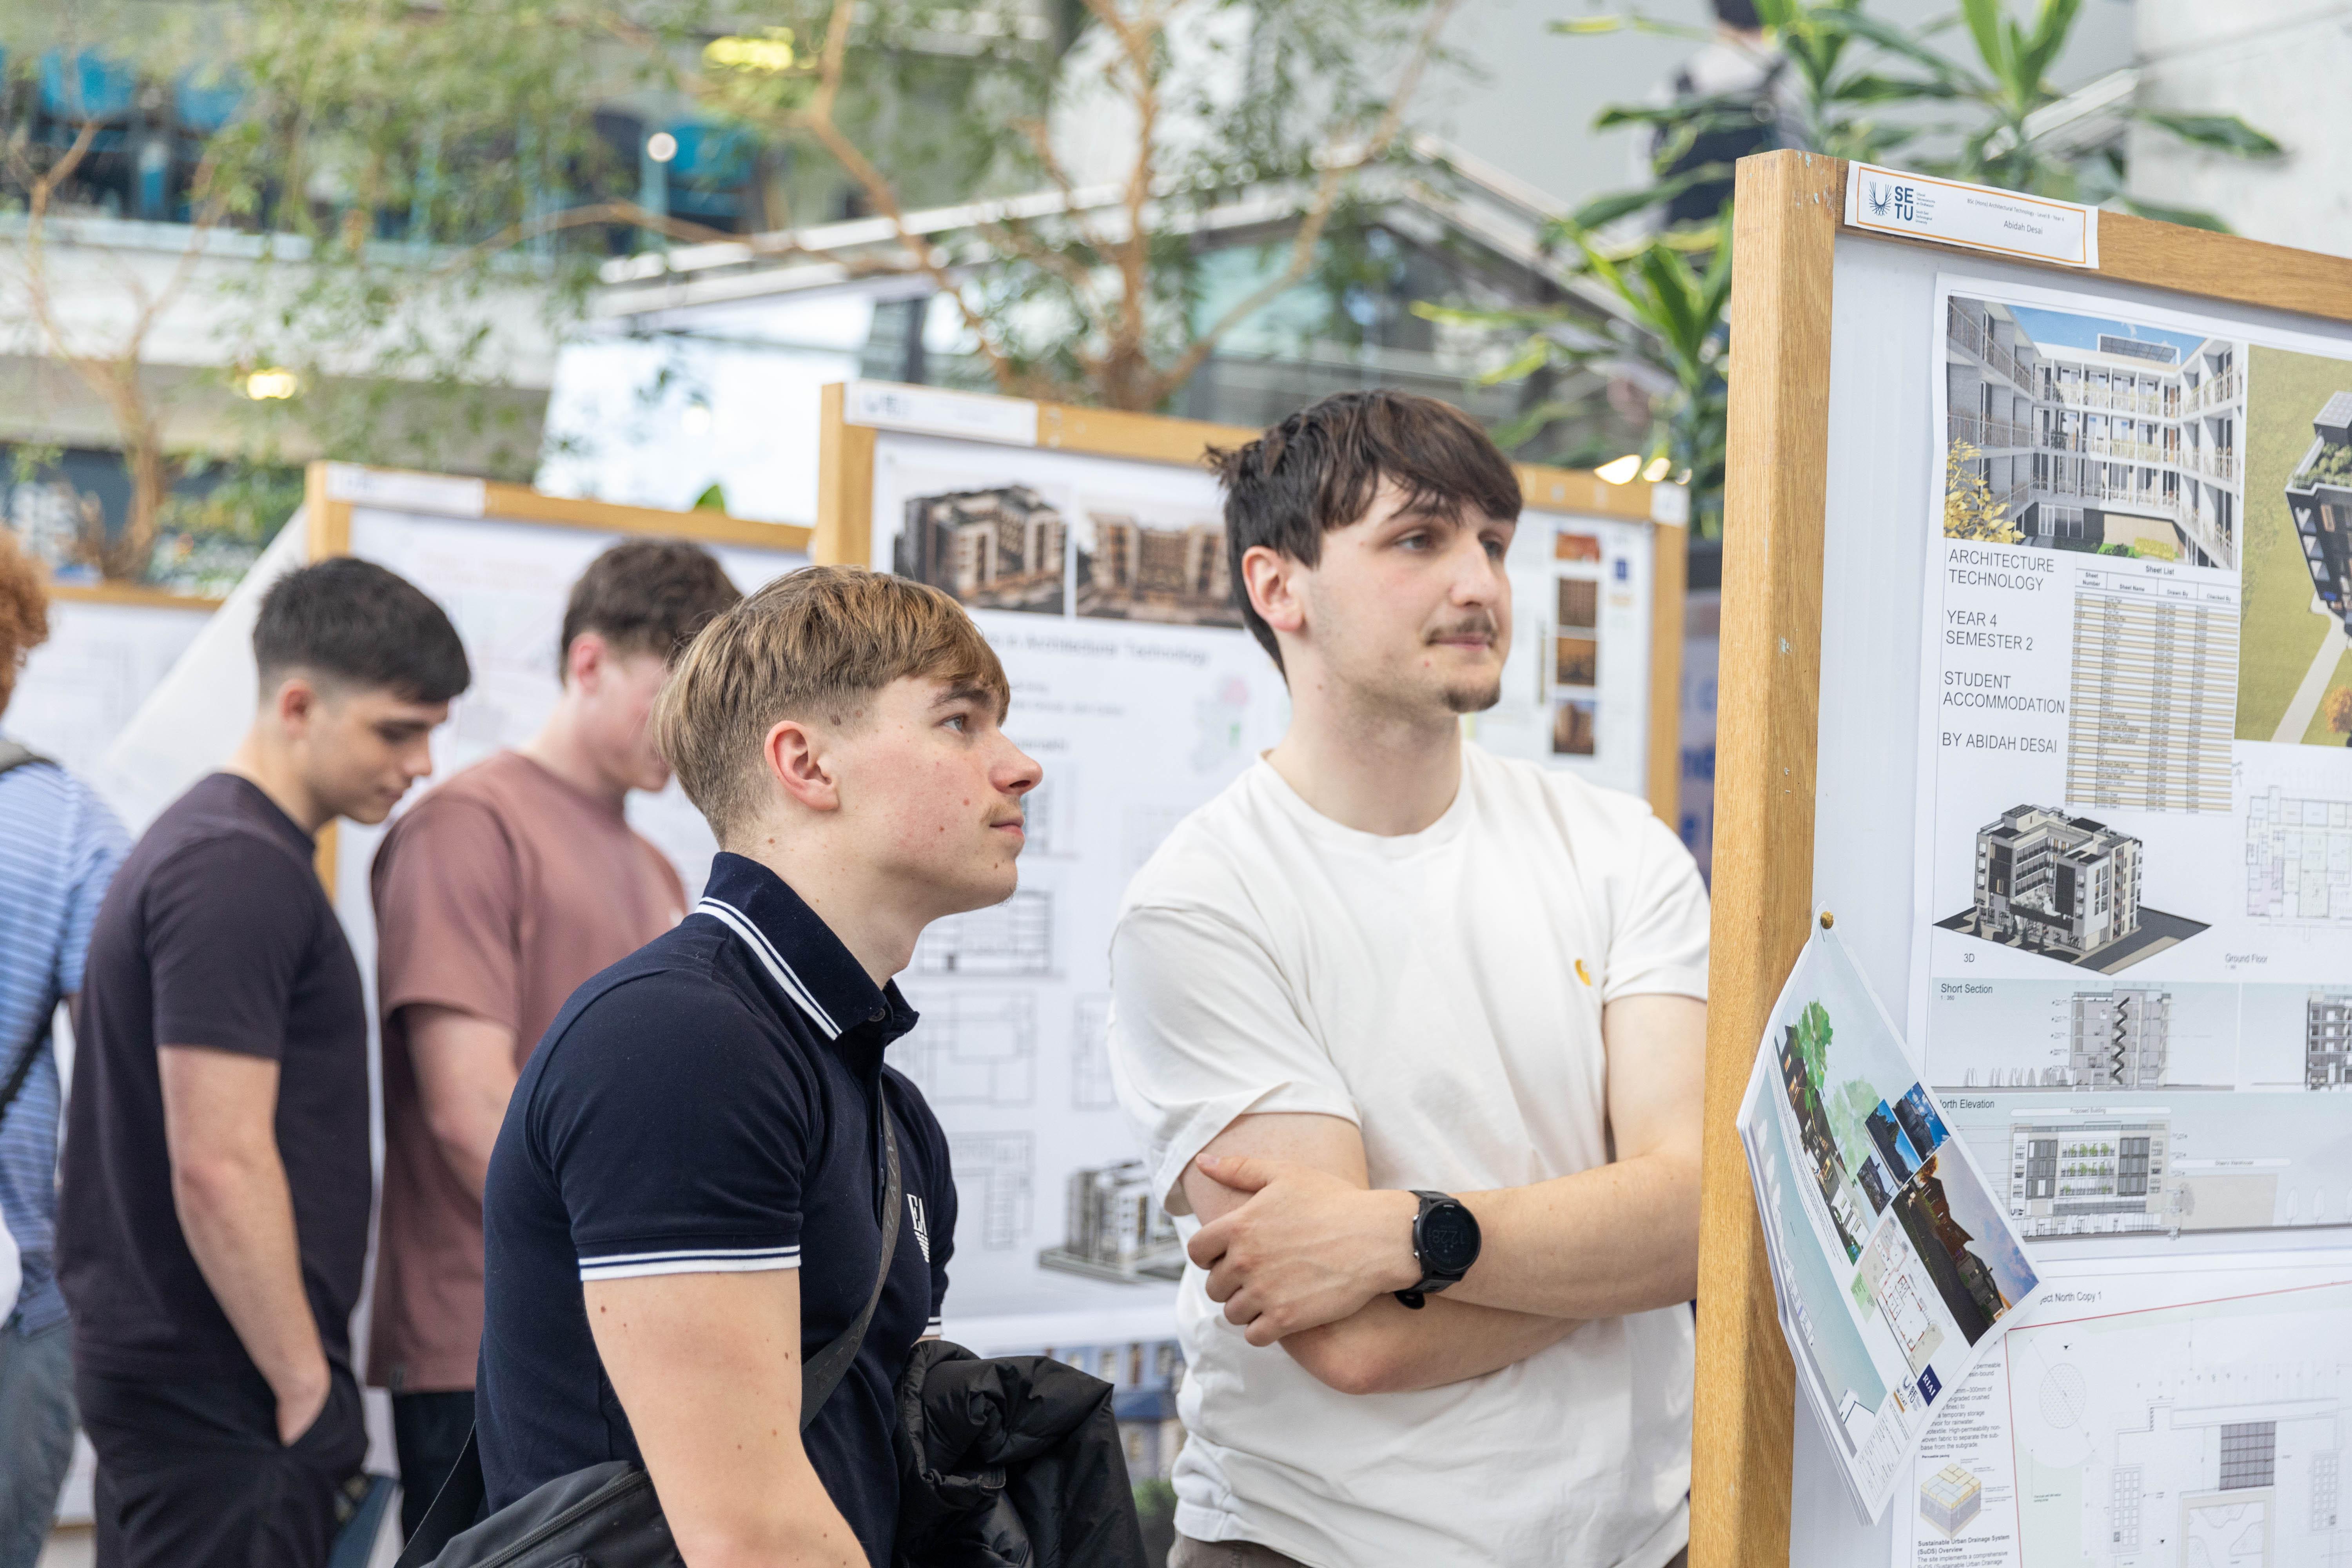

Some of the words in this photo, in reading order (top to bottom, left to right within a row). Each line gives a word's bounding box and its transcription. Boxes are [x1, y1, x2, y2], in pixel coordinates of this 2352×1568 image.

[1895, 186, 1914, 204] SE
[1895, 203, 1913, 221] TU
[1989, 201, 2013, 211] Architectural
[2014, 207, 2034, 216] Technology
[2004, 220, 2025, 231] Abidah
[2027, 225, 2043, 234] Desai
[1949, 549, 2055, 573] ARCHITECTURE
[2146, 565, 2162, 574] Sheet
[2164, 567, 2174, 575] List
[1949, 569, 2043, 592] TECHNOLOGY
[1947, 610, 1985, 626] YEAR
[1990, 613, 1997, 627] 4
[1946, 631, 2024, 650] SEMESTER
[2025, 637, 2033, 651] 2
[1944, 671, 2011, 689] STUDENT
[1943, 692, 2065, 714] ACCOMMODATION
[1942, 733, 1962, 747] BY
[1966, 735, 2016, 750] ABIDAH
[2021, 737, 2057, 753] DESAI
[1964, 953, 1975, 963] 3D
[2225, 953, 2250, 963] Ground
[2251, 954, 2268, 963] Floor
[1941, 983, 1962, 993] Short
[1965, 984, 1993, 993] Section
[1960, 1099, 1995, 1109] Elevation
[2056, 1292, 2075, 1302] North
[2077, 1292, 2096, 1303] Copy
[2098, 1290, 2102, 1300] 1
[1923, 1374, 1936, 1396] RIAI
[1949, 1426, 1989, 1434] High-permeability
